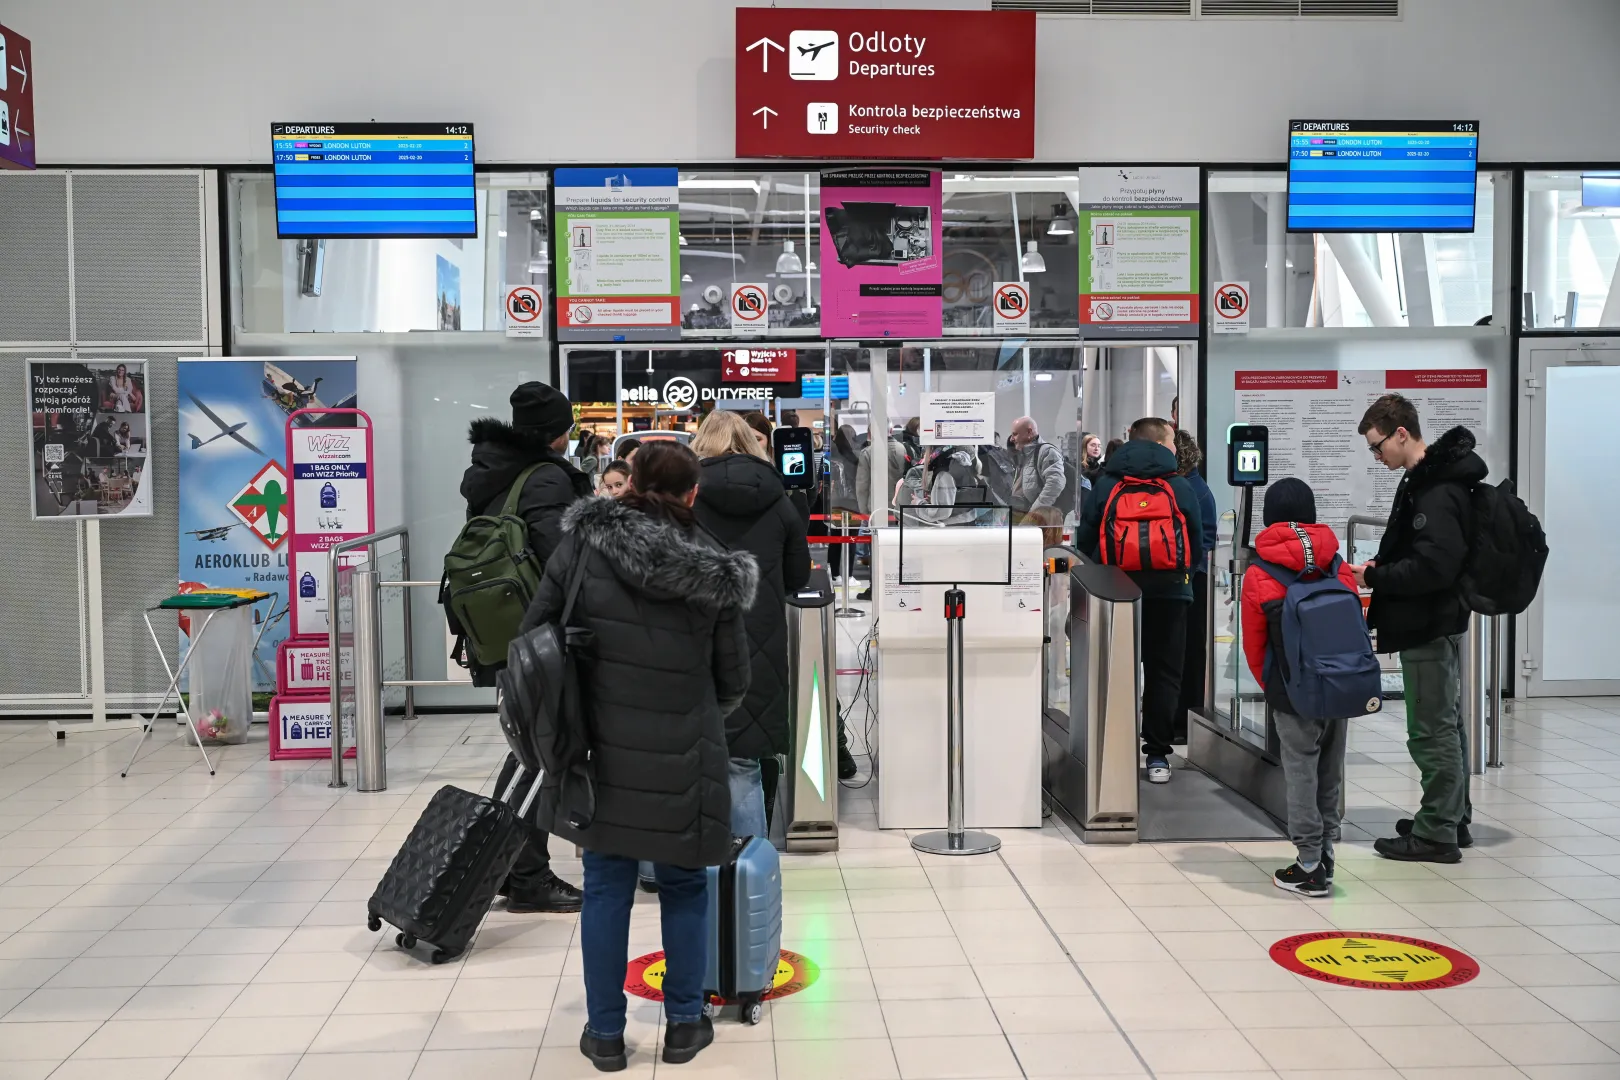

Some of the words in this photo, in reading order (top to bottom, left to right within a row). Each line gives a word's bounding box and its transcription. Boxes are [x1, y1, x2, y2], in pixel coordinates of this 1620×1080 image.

[849, 31, 926, 58] Odloty
[849, 61, 935, 78] Departures
[849, 104, 907, 118] Kontrola
[912, 105, 1021, 120] bezpieczeństwa
[285, 126, 335, 134] DEPARTURES
[445, 126, 468, 134] 14:12
[848, 124, 889, 136] Security
[892, 125, 920, 134] check
[1303, 122, 1350, 131] DEPARTURES
[1452, 124, 1473, 132] 14:12
[34, 375, 45, 384] Ty
[47, 375, 60, 384] też
[62, 375, 93, 384] możesz
[35, 385, 77, 394] rozpocząć
[701, 388, 773, 400] DUTYFREE
[35, 396, 59, 404] swoją
[62, 396, 91, 404] podróż
[45, 406, 90, 414] komforcie!
[308, 434, 350, 453] WIZZ
[195, 553, 270, 568] AEROKLUB
[1360, 932, 1443, 951] DYSTANS
[1344, 954, 1401, 964] 1,5m
[1300, 968, 1392, 989] DISTANCE
[1400, 980, 1446, 990] YOUR
